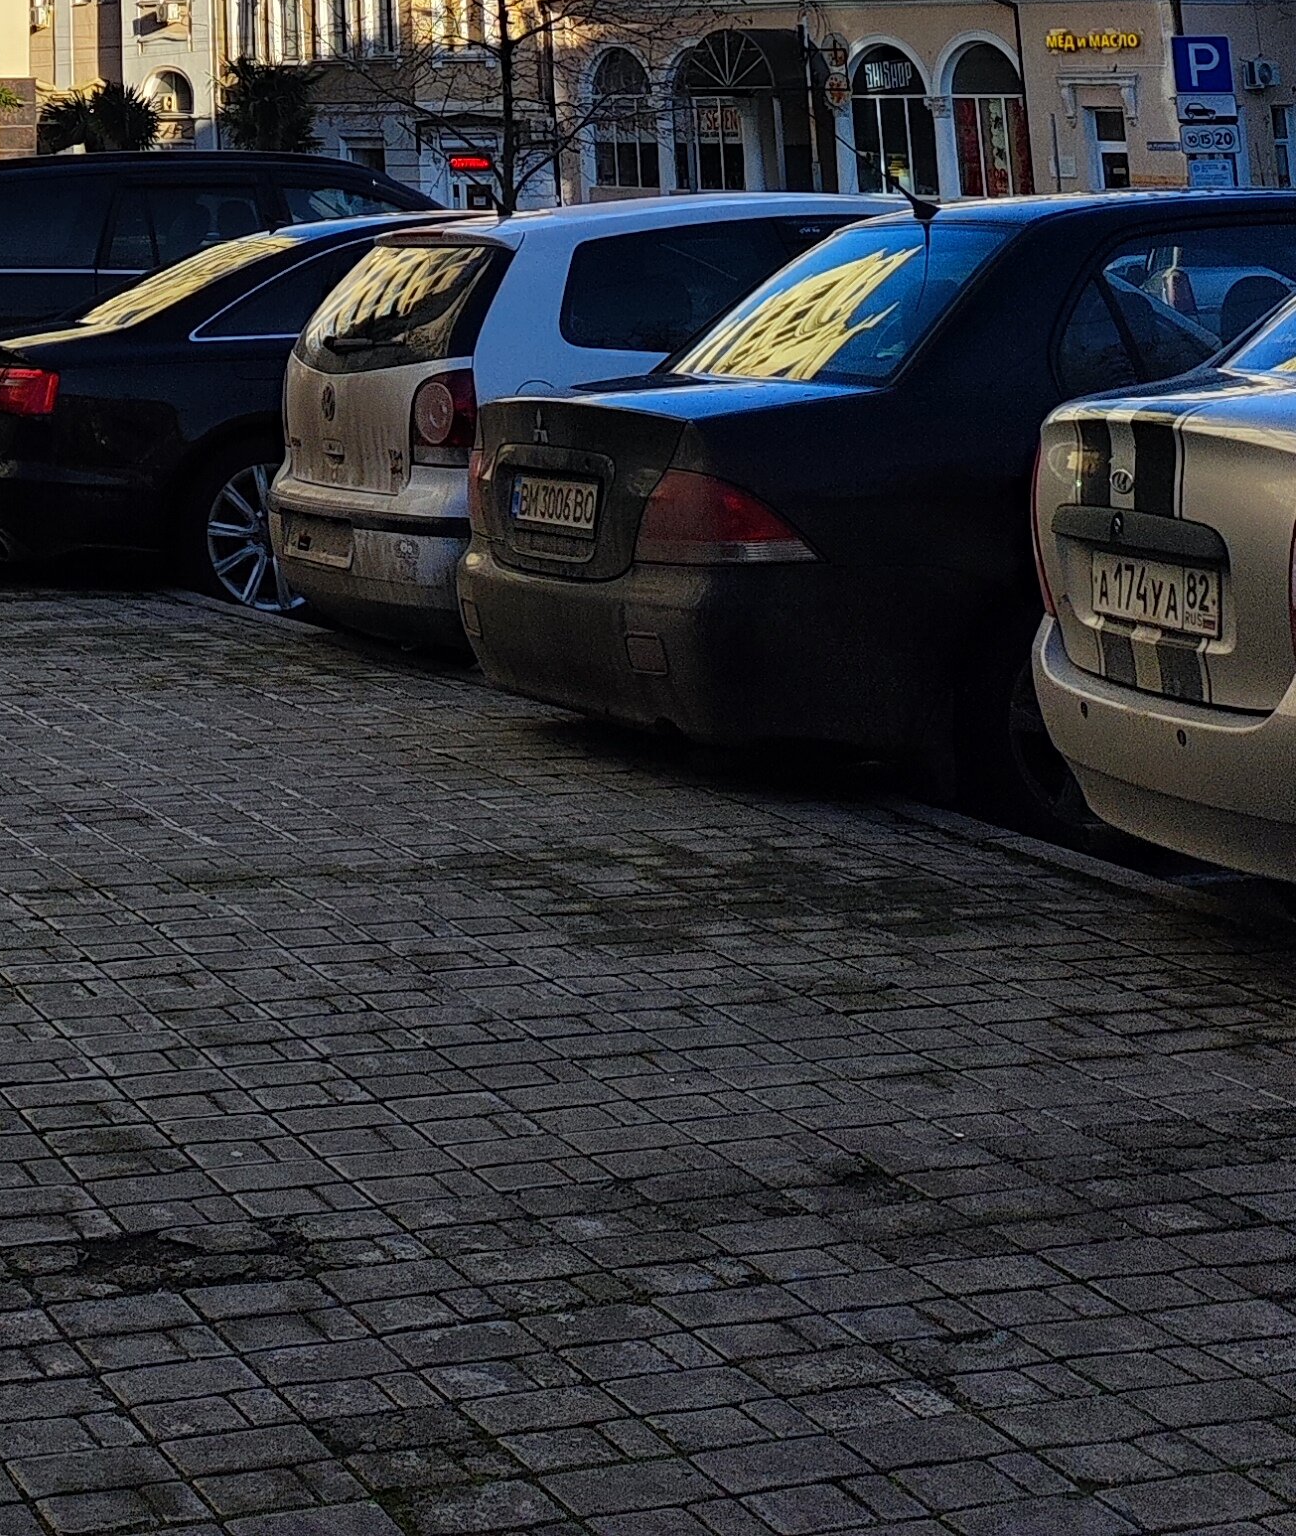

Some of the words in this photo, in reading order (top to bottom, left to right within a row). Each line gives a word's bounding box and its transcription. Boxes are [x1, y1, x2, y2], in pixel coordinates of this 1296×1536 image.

[1046, 34, 1075, 51] МЕД
[1089, 33, 1138, 48] МАСЛО
[1188, 42, 1220, 87] P
[1200, 134, 1211, 145] 15
[1215, 132, 1233, 145] 20
[1186, 573, 1210, 612] 82
[1185, 611, 1203, 627] RUS
